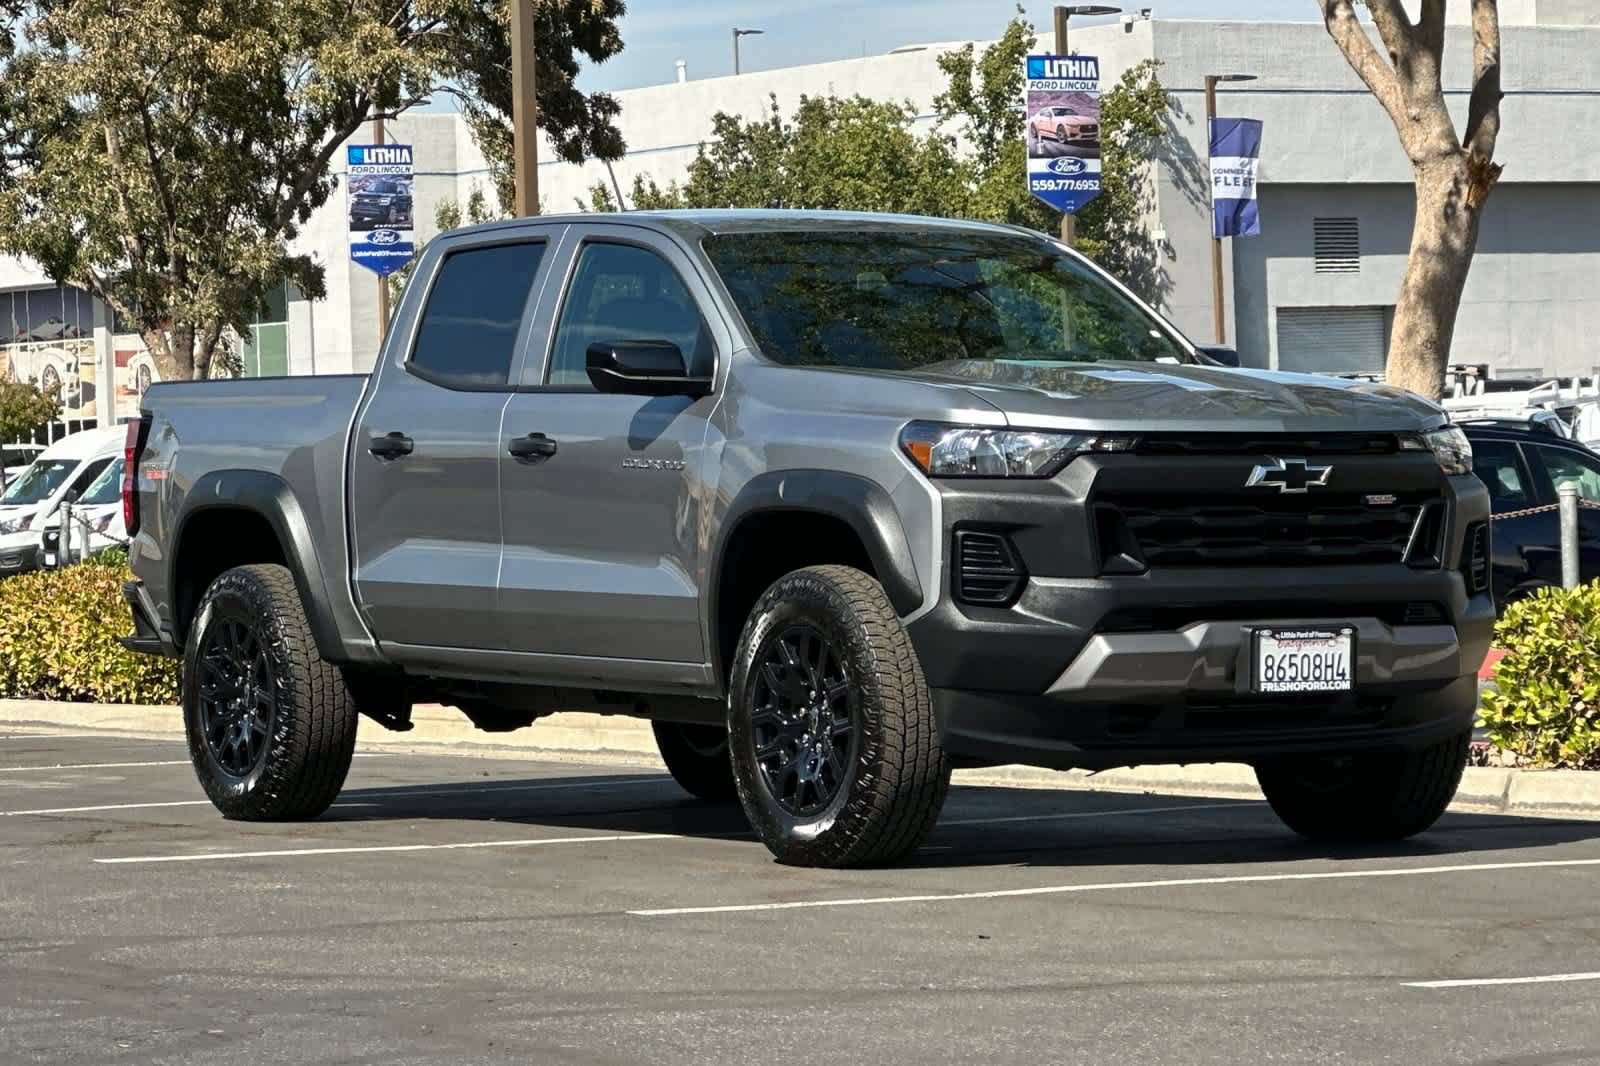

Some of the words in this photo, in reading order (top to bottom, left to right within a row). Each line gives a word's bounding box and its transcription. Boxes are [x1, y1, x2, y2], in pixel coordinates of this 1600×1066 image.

[1044, 60, 1098, 78] LITHIA
[1030, 81, 1058, 90] FORD
[1059, 81, 1097, 90] LINCOLN
[363, 148, 411, 163] LITHIA
[351, 166, 375, 174] FORD
[376, 166, 410, 174] LINCOLN
[1055, 158, 1081, 172] Ford
[1031, 180, 1101, 191] 559.777.6952
[1264, 652, 1346, 682] 86508H4
